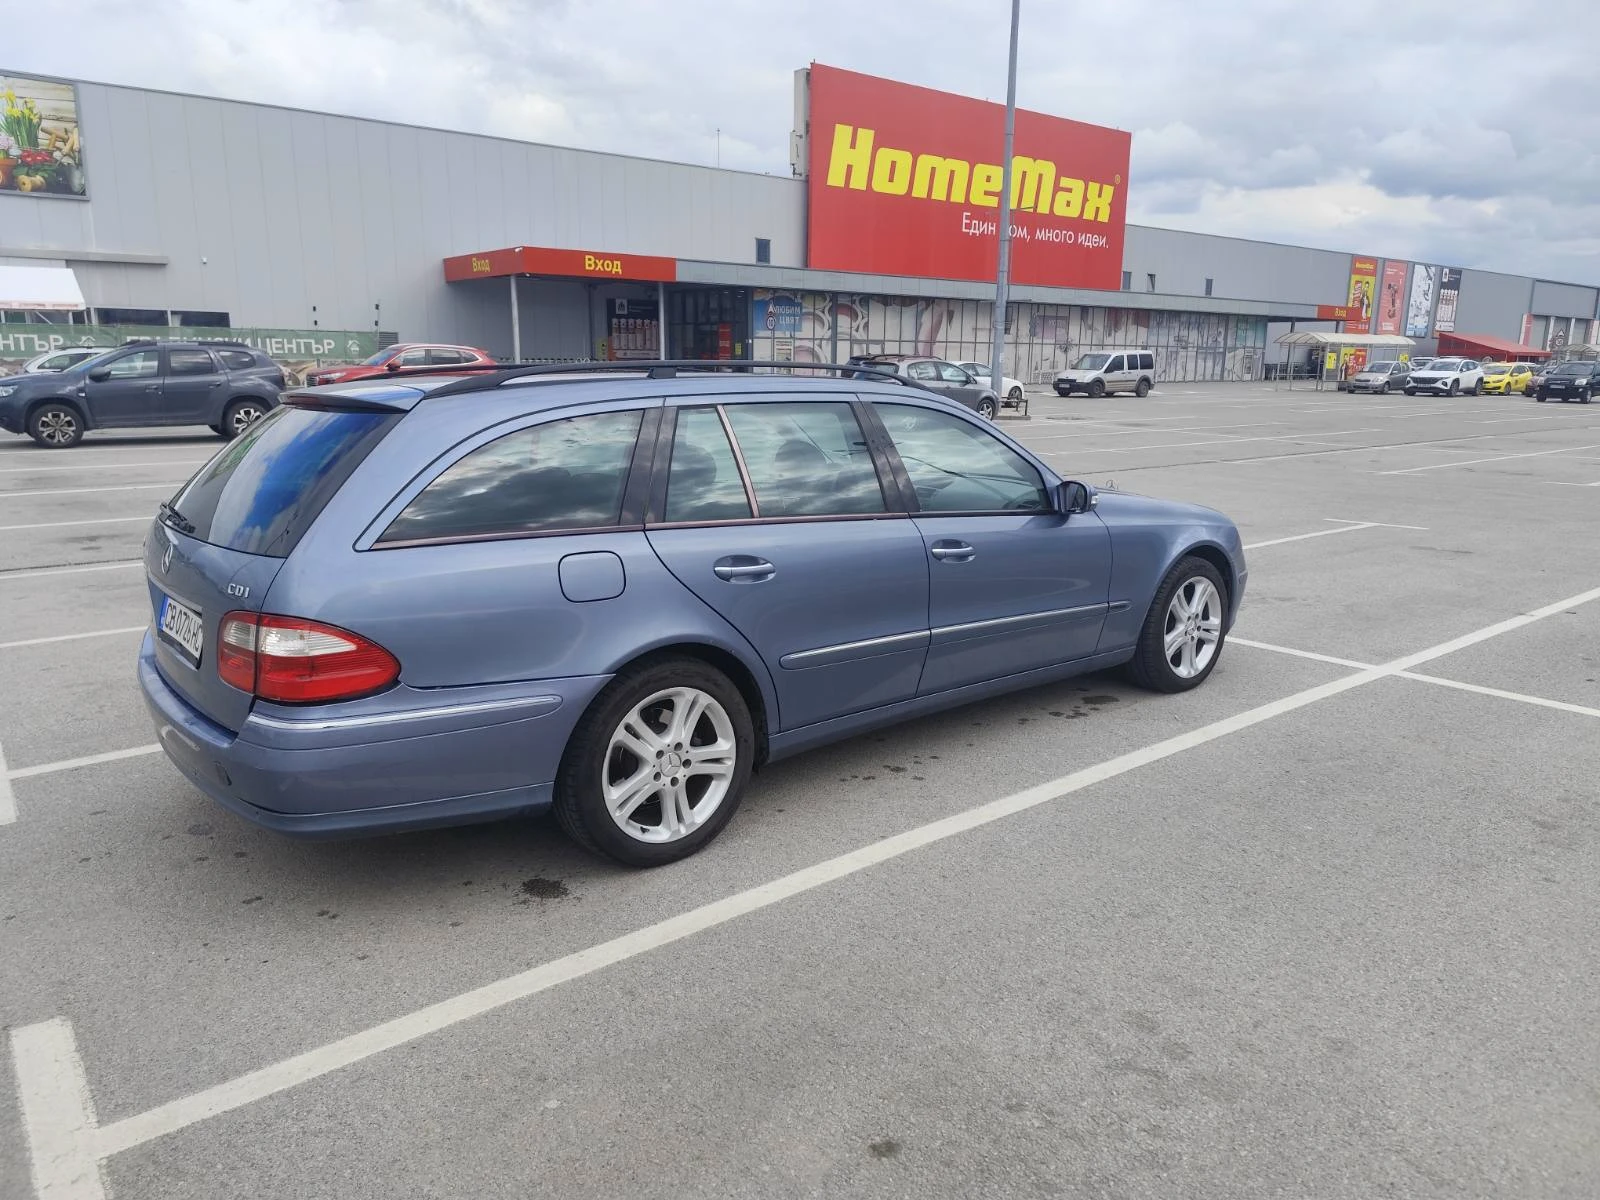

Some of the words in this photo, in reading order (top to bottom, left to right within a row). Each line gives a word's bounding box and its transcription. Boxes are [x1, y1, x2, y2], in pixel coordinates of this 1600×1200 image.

[826, 123, 1115, 223] HomeMax
[961, 212, 996, 236] Един
[1008, 224, 1031, 244] ом,
[1035, 229, 1075, 245] много
[1077, 232, 1109, 249] идеи.
[472, 257, 490, 272] Вход
[584, 254, 622, 275] Вход
[258, 337, 336, 355] ЦЕНТЪР
[227, 583, 250, 598] CDI
